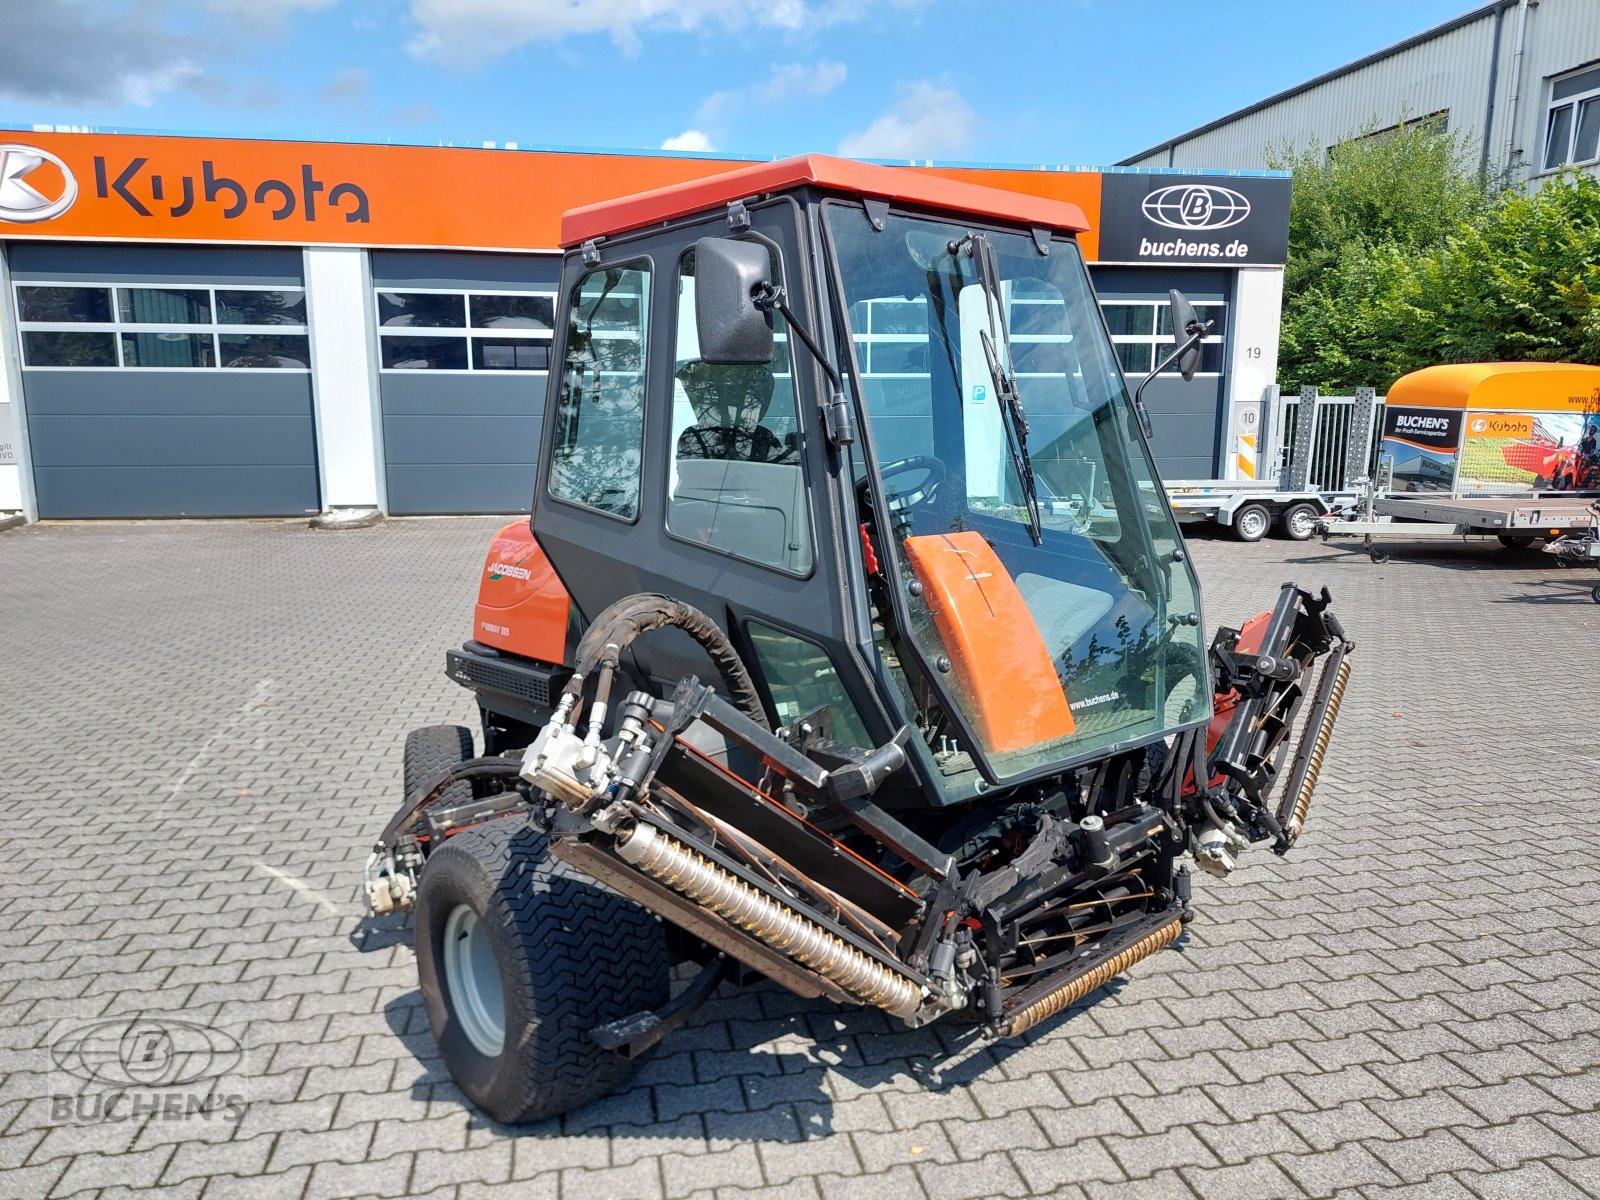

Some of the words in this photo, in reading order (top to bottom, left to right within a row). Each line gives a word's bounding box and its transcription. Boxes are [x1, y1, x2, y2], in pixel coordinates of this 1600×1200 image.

[93, 156, 370, 223] Kubota
[1139, 238, 1249, 257] buchens.de
[1247, 347, 1261, 359] 19
[1243, 412, 1255, 424] 10
[1396, 415, 1450, 430] BUCHEN'S
[1489, 420, 1528, 432] Kubota
[488, 561, 532, 580] JACOBSEN
[1069, 691, 1119, 710] www.buchens.de
